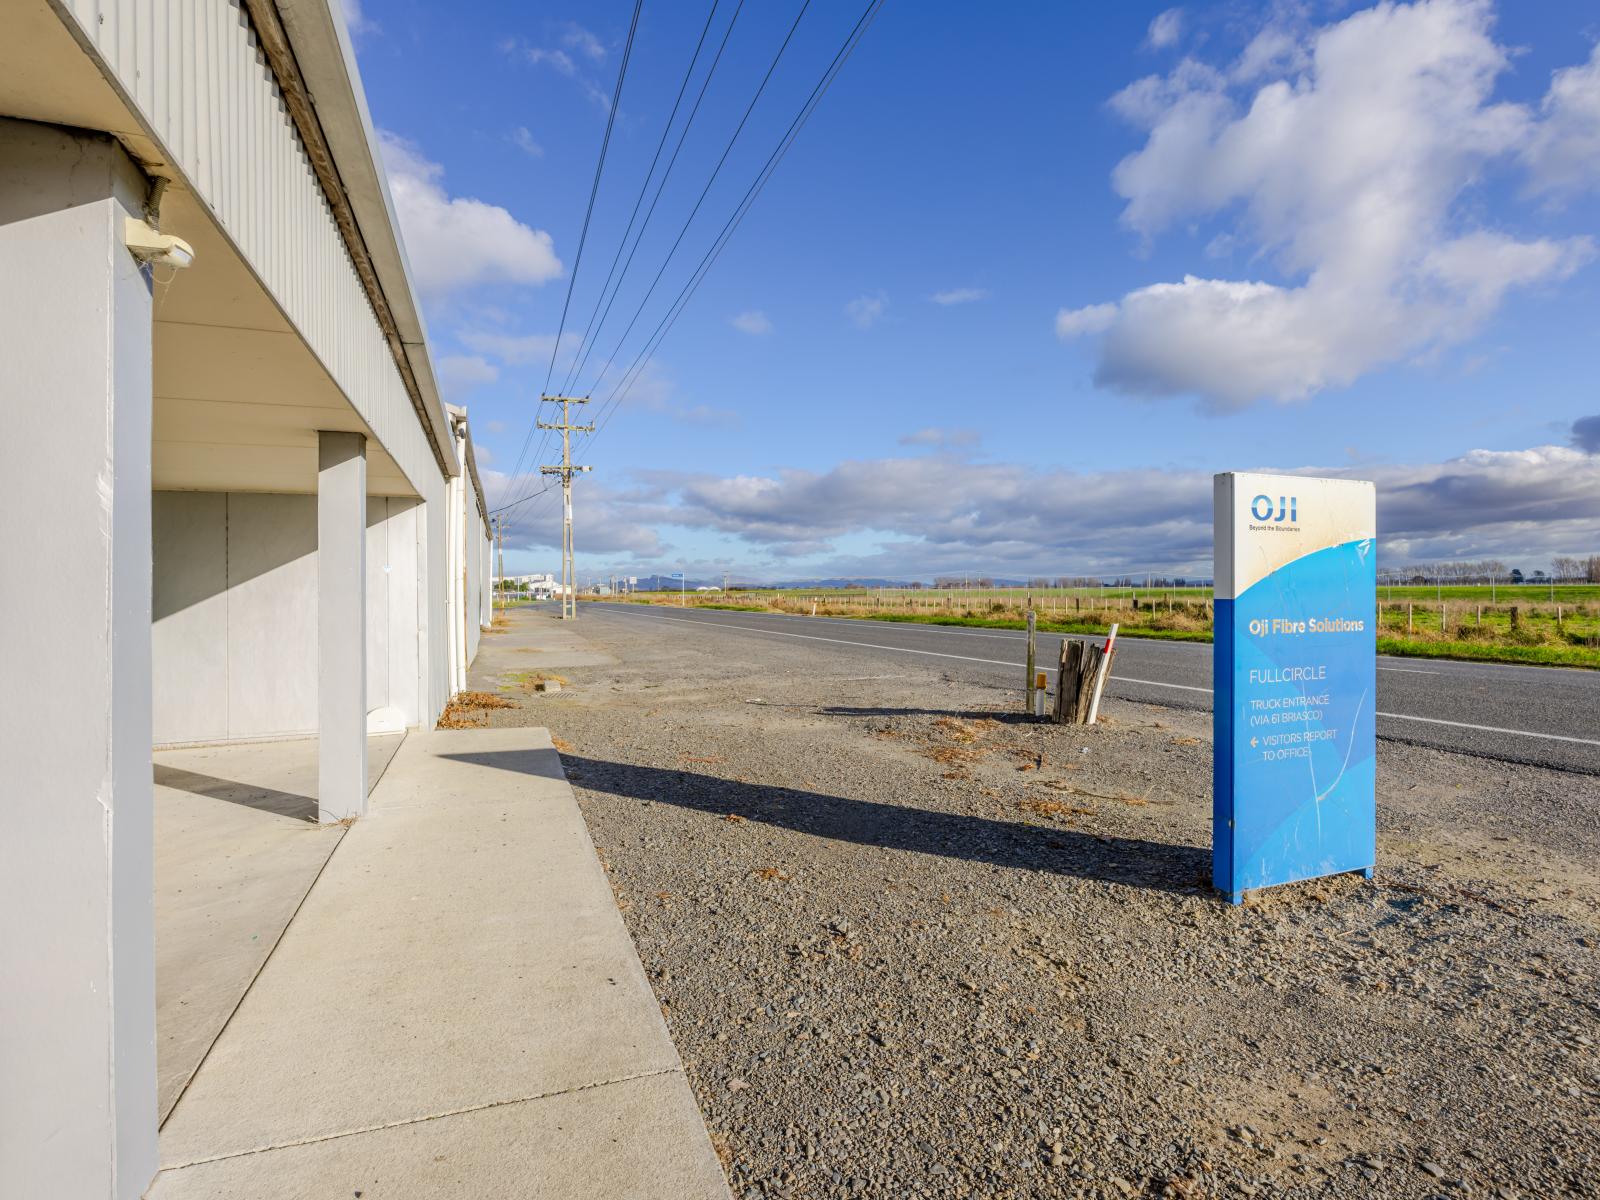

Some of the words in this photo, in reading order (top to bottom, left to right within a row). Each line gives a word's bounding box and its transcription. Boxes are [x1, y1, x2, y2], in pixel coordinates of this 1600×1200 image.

[1251, 494, 1297, 522] OJI
[1249, 524, 1267, 532] Beyond
[1249, 619, 1269, 637] Oji
[1273, 618, 1306, 634] Fibre
[1309, 617, 1364, 632] Solutions
[1250, 666, 1327, 684] FULLCIRCLE
[1250, 698, 1281, 710] TRUCK
[1283, 695, 1330, 708] ENTRANCE
[1250, 714, 1270, 728] (VIA
[1271, 713, 1280, 725] 61
[1281, 710, 1323, 723] BRIASCO)
[1262, 732, 1302, 746] VISITORS
[1303, 729, 1337, 742] REPORT
[1262, 750, 1275, 761] TO
[1277, 746, 1310, 760] OFFICE
